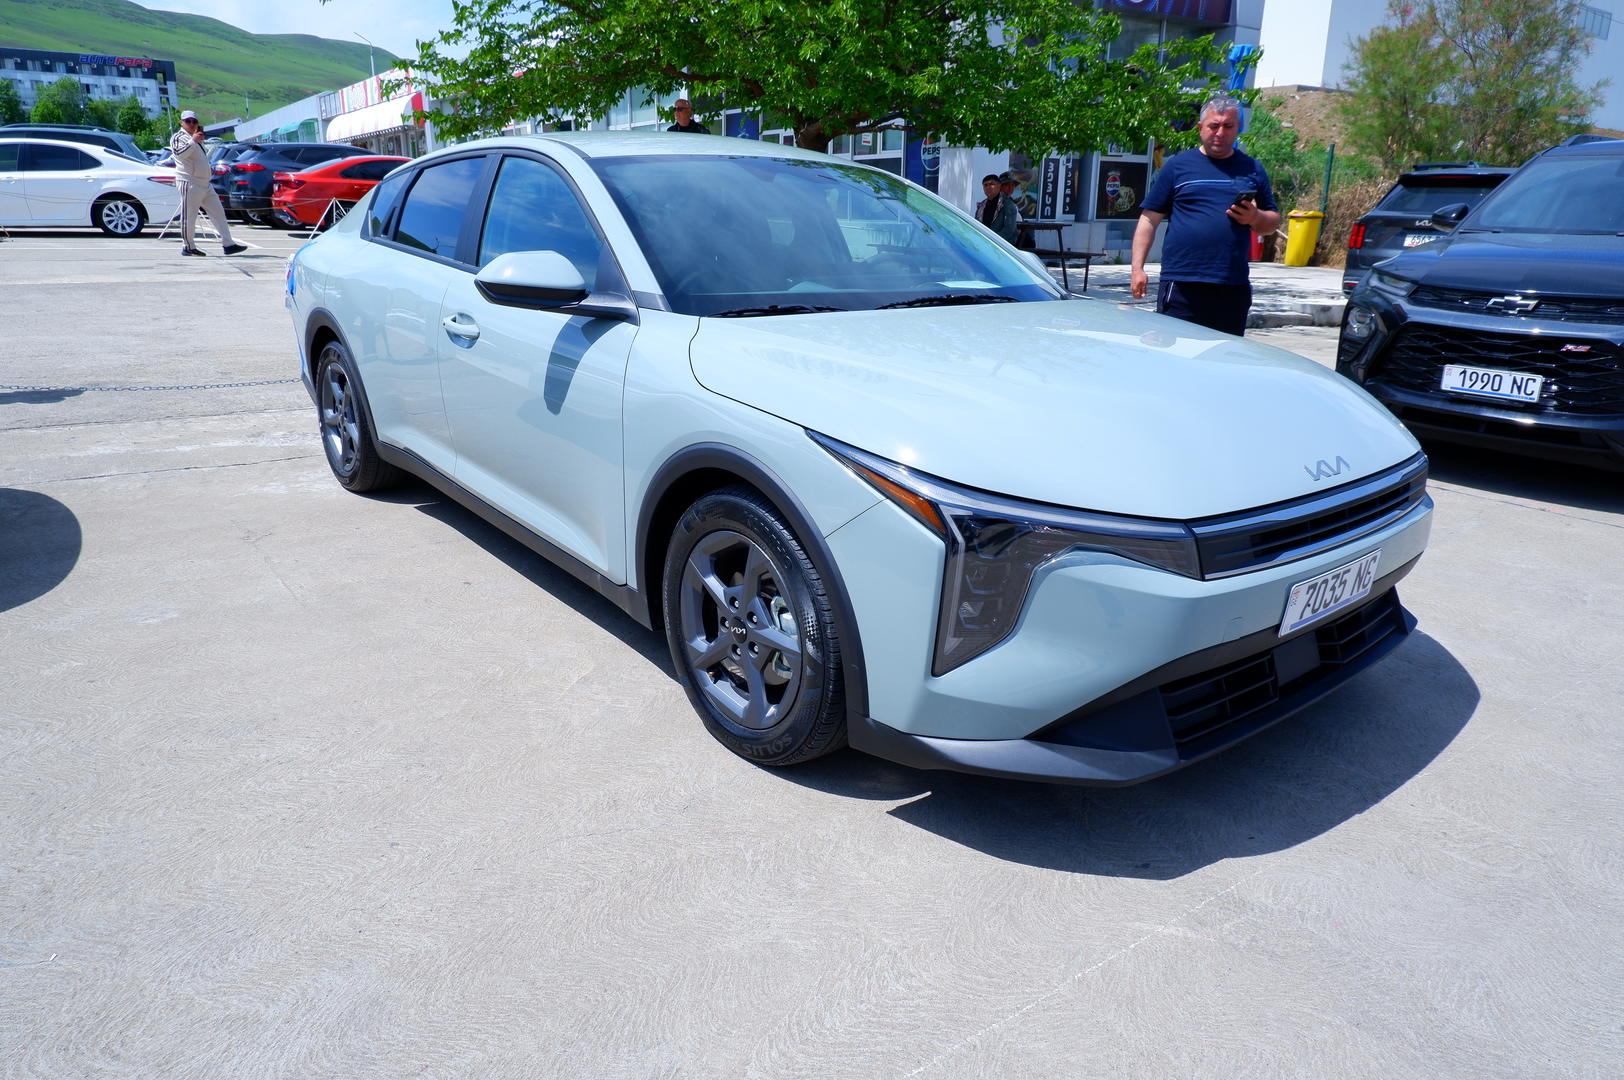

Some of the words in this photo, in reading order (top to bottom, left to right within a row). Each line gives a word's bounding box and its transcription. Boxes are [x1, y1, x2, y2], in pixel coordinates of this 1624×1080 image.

[922, 146, 940, 155] PEPS
[1459, 368, 1503, 392] 1990
[1510, 376, 1536, 396] NC
[1299, 568, 1351, 620] 7035
